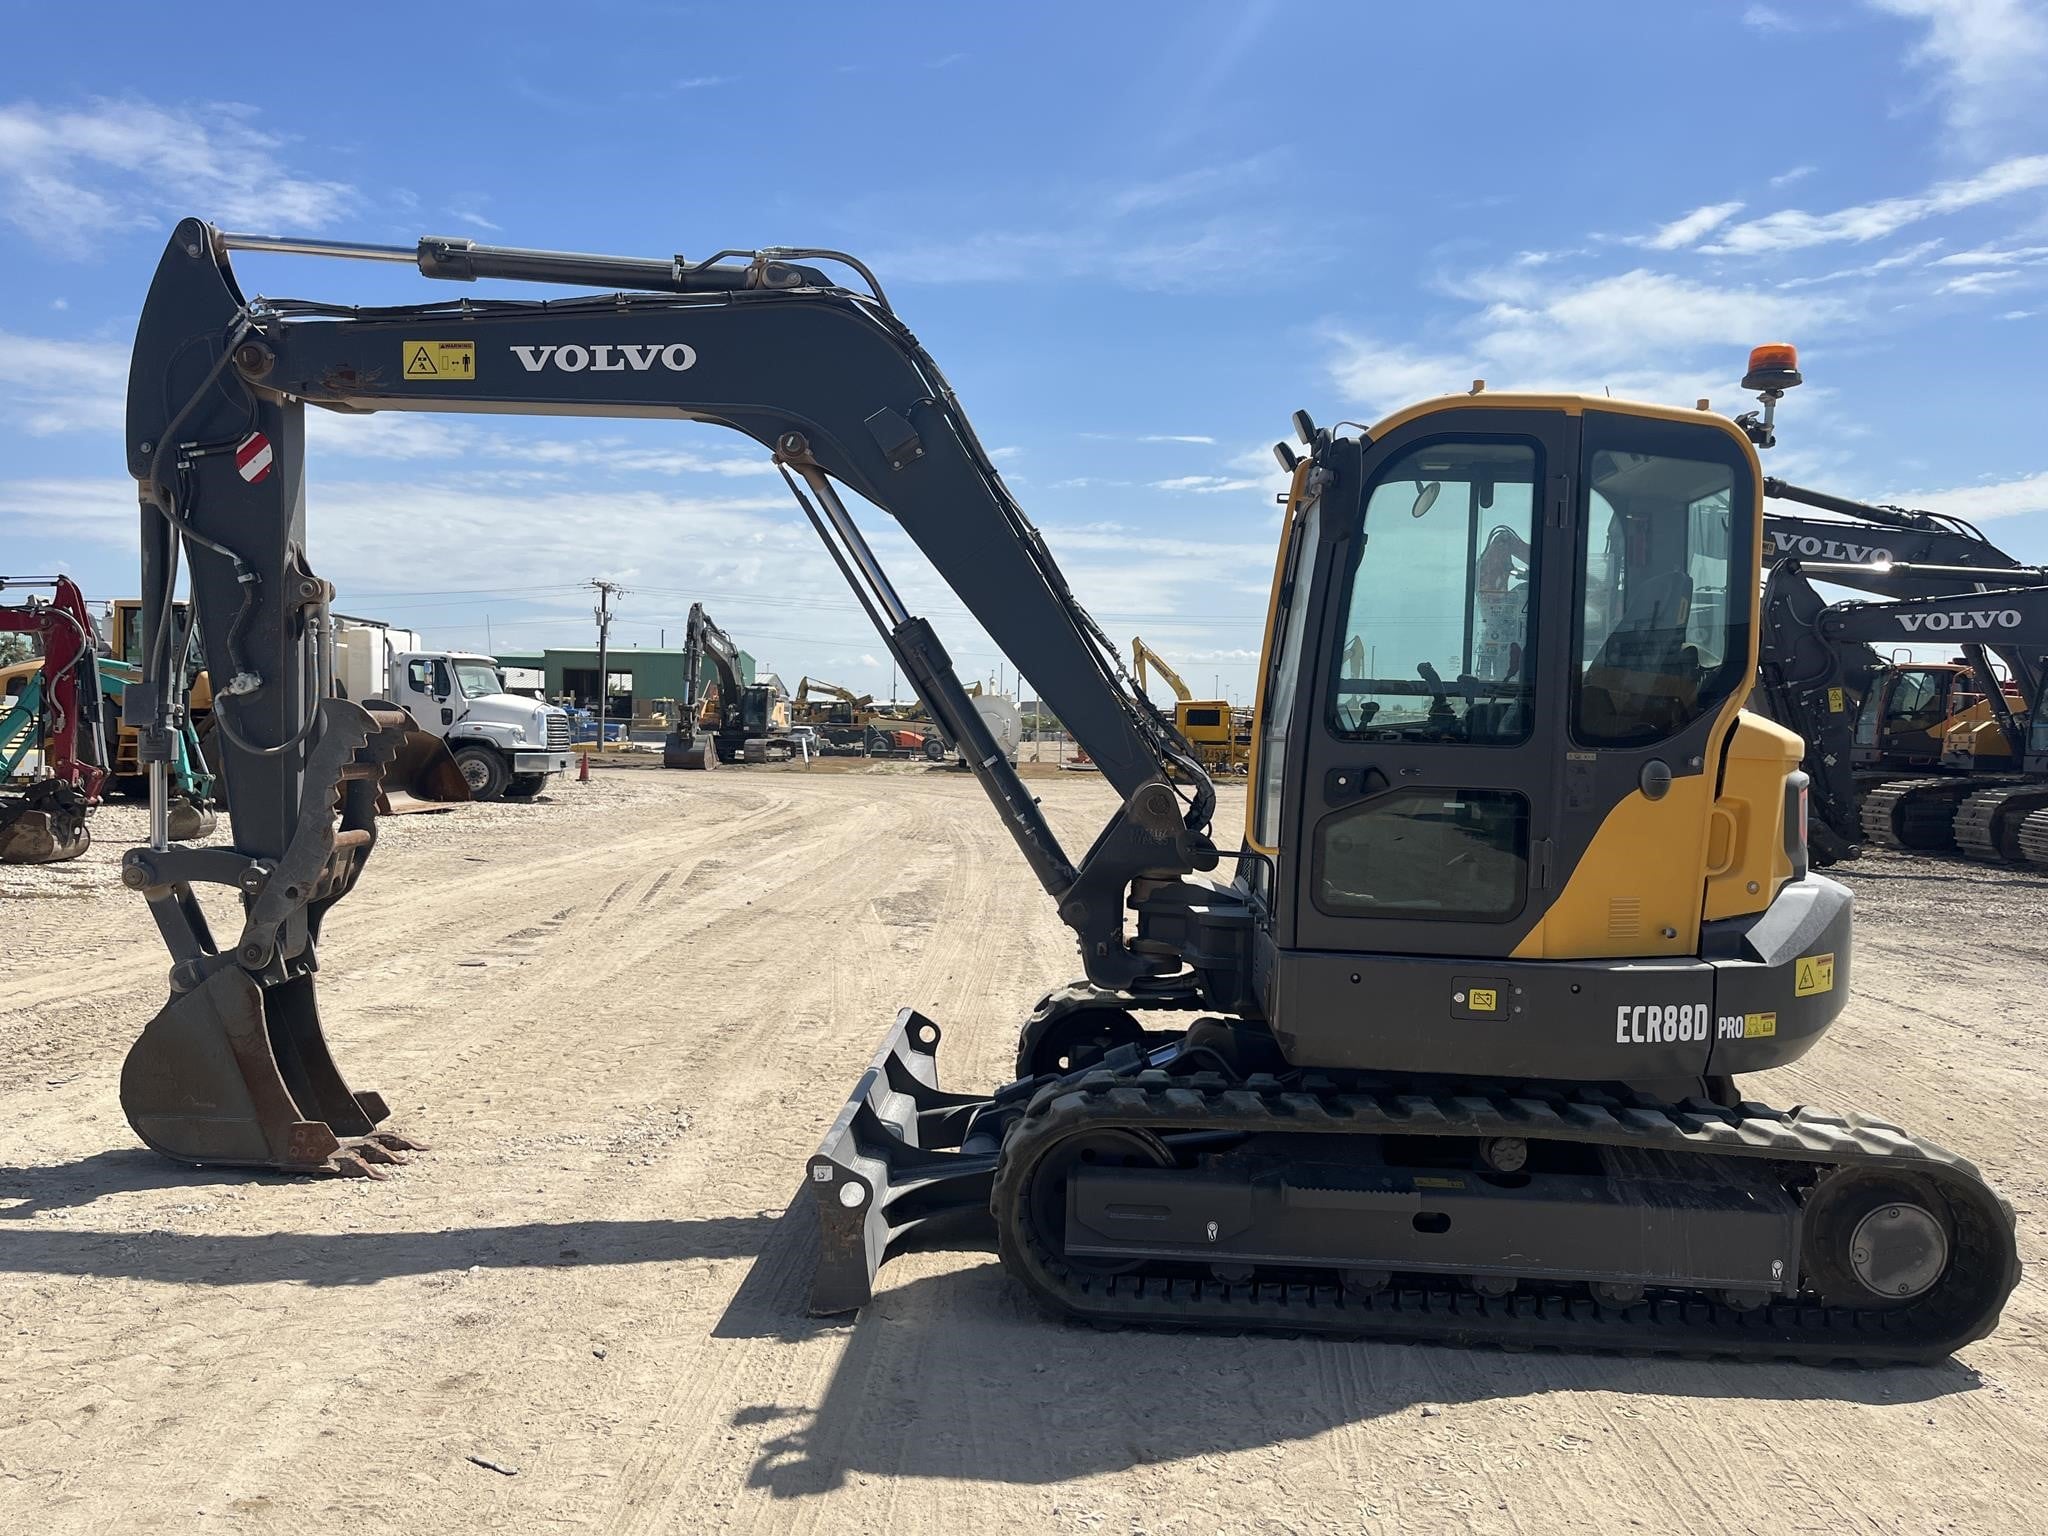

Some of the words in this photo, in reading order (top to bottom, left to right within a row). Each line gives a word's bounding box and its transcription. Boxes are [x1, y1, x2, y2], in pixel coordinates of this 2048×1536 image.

[510, 344, 696, 373] VOLVO
[1771, 531, 1894, 563] VOLVO
[1895, 609, 2022, 632] VOLVO
[1616, 1003, 1708, 1043] ECR88D
[1718, 1015, 1744, 1039] PRO
